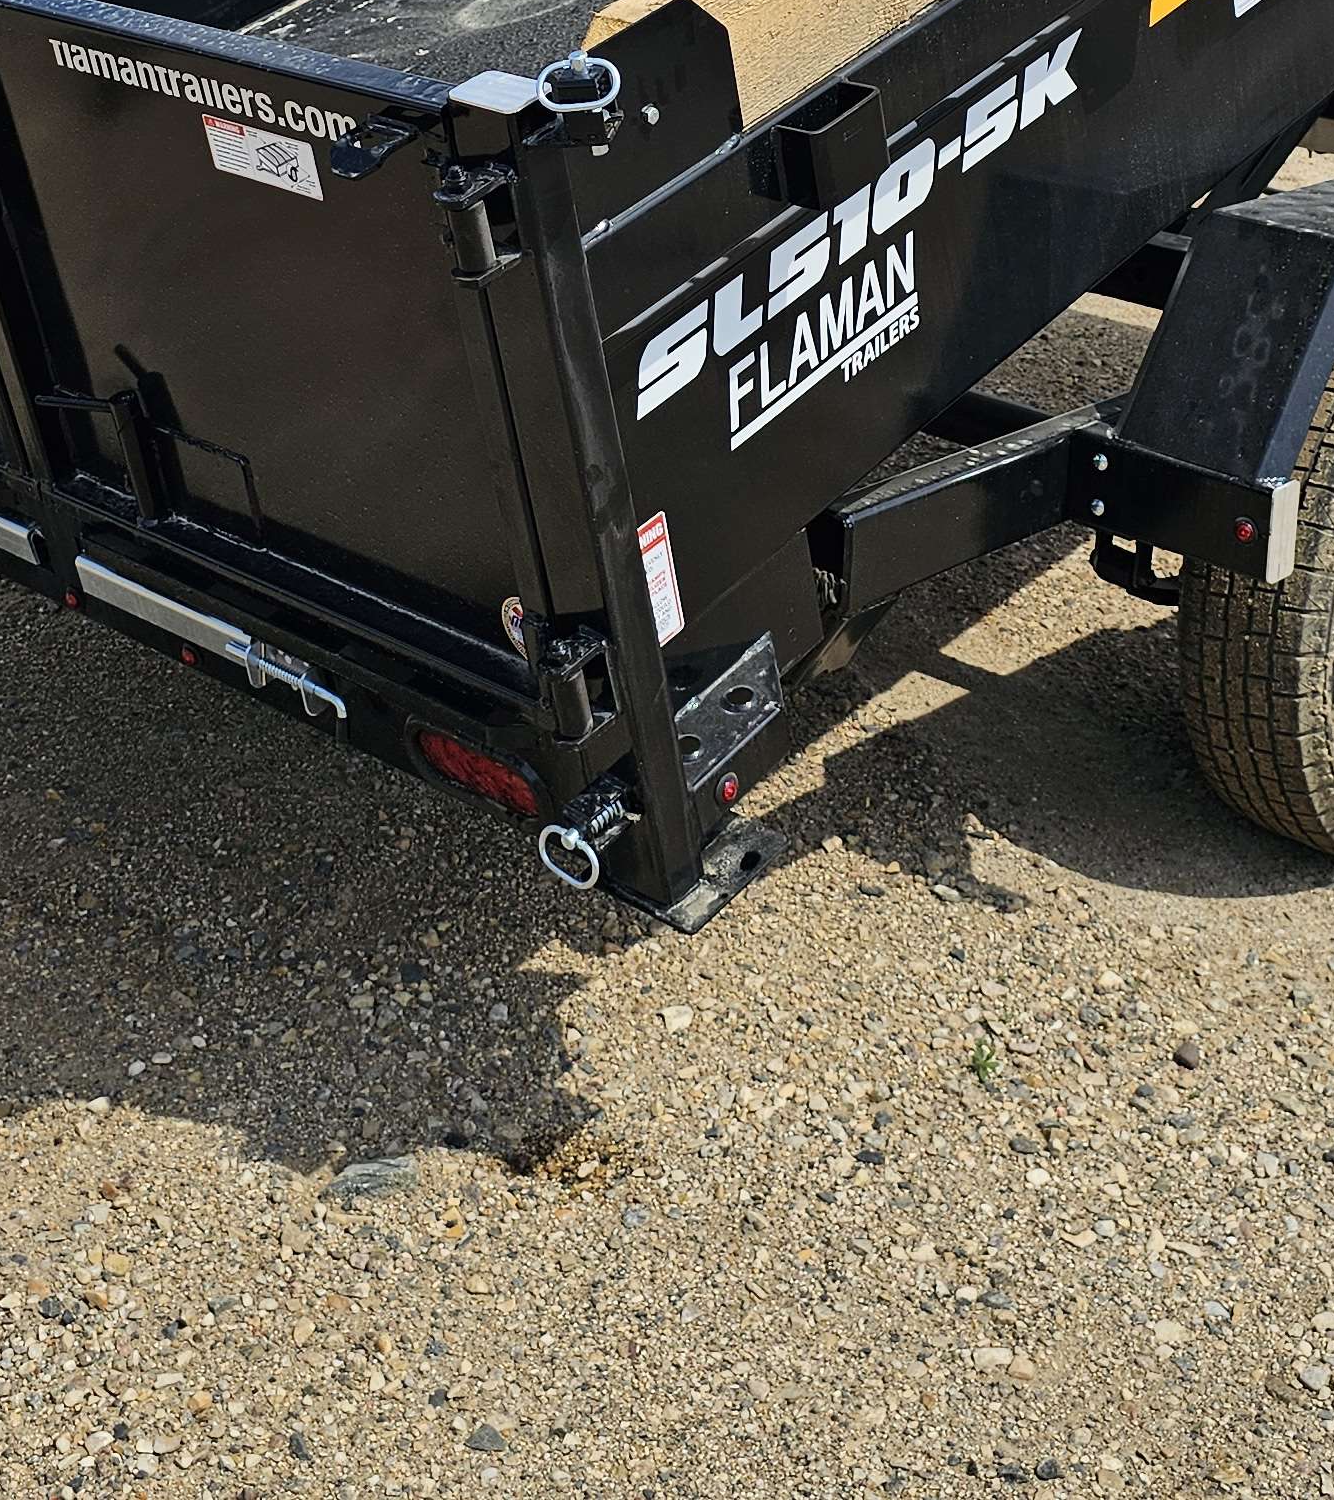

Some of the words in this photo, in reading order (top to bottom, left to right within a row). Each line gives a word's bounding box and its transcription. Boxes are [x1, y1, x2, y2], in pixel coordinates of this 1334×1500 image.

[637, 28, 1083, 421] SL510-5K
[729, 230, 915, 433] FLAMAN
[841, 306, 920, 382] TRAILERS
[639, 522, 664, 548] NING
